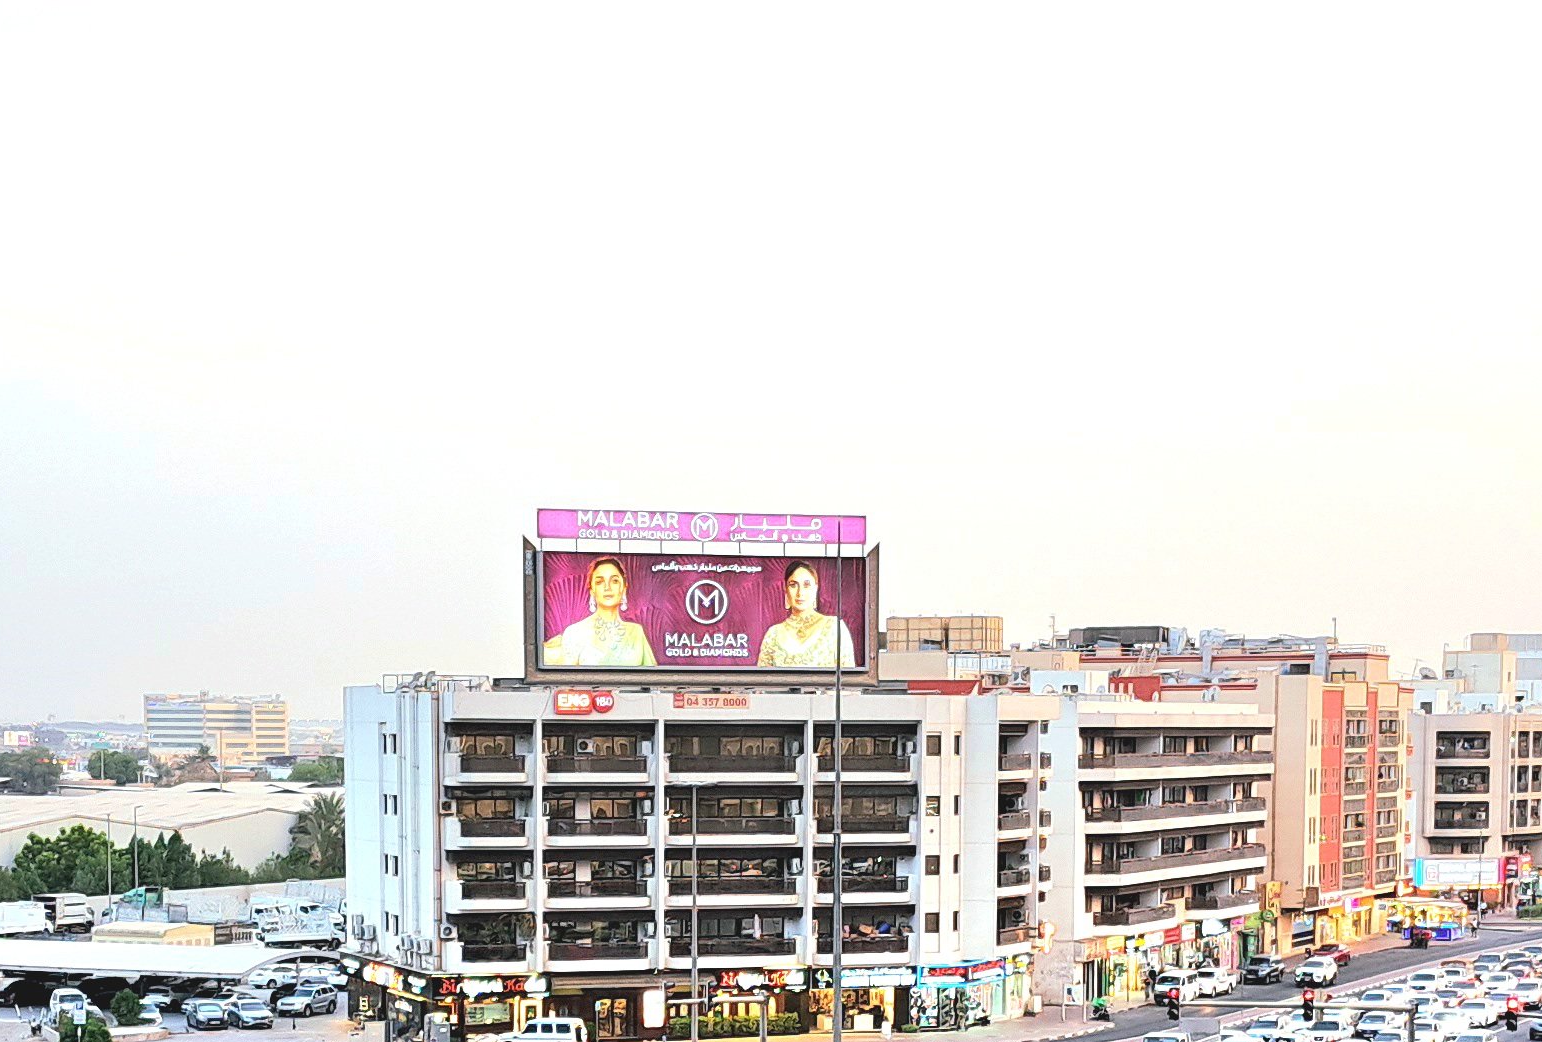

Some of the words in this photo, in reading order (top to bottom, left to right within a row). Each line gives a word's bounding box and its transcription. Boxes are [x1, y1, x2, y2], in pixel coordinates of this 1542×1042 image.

[577, 511, 679, 528] MALABAR
[578, 529, 608, 539] GOLD
[611, 530, 618, 538] &
[620, 530, 680, 540] DIAMONDS
[665, 633, 748, 647] MALABAR
[665, 648, 691, 656] GOLD
[700, 648, 749, 657] DIAMONDS
[686, 698, 699, 706] 04
[702, 698, 719, 706] 357
